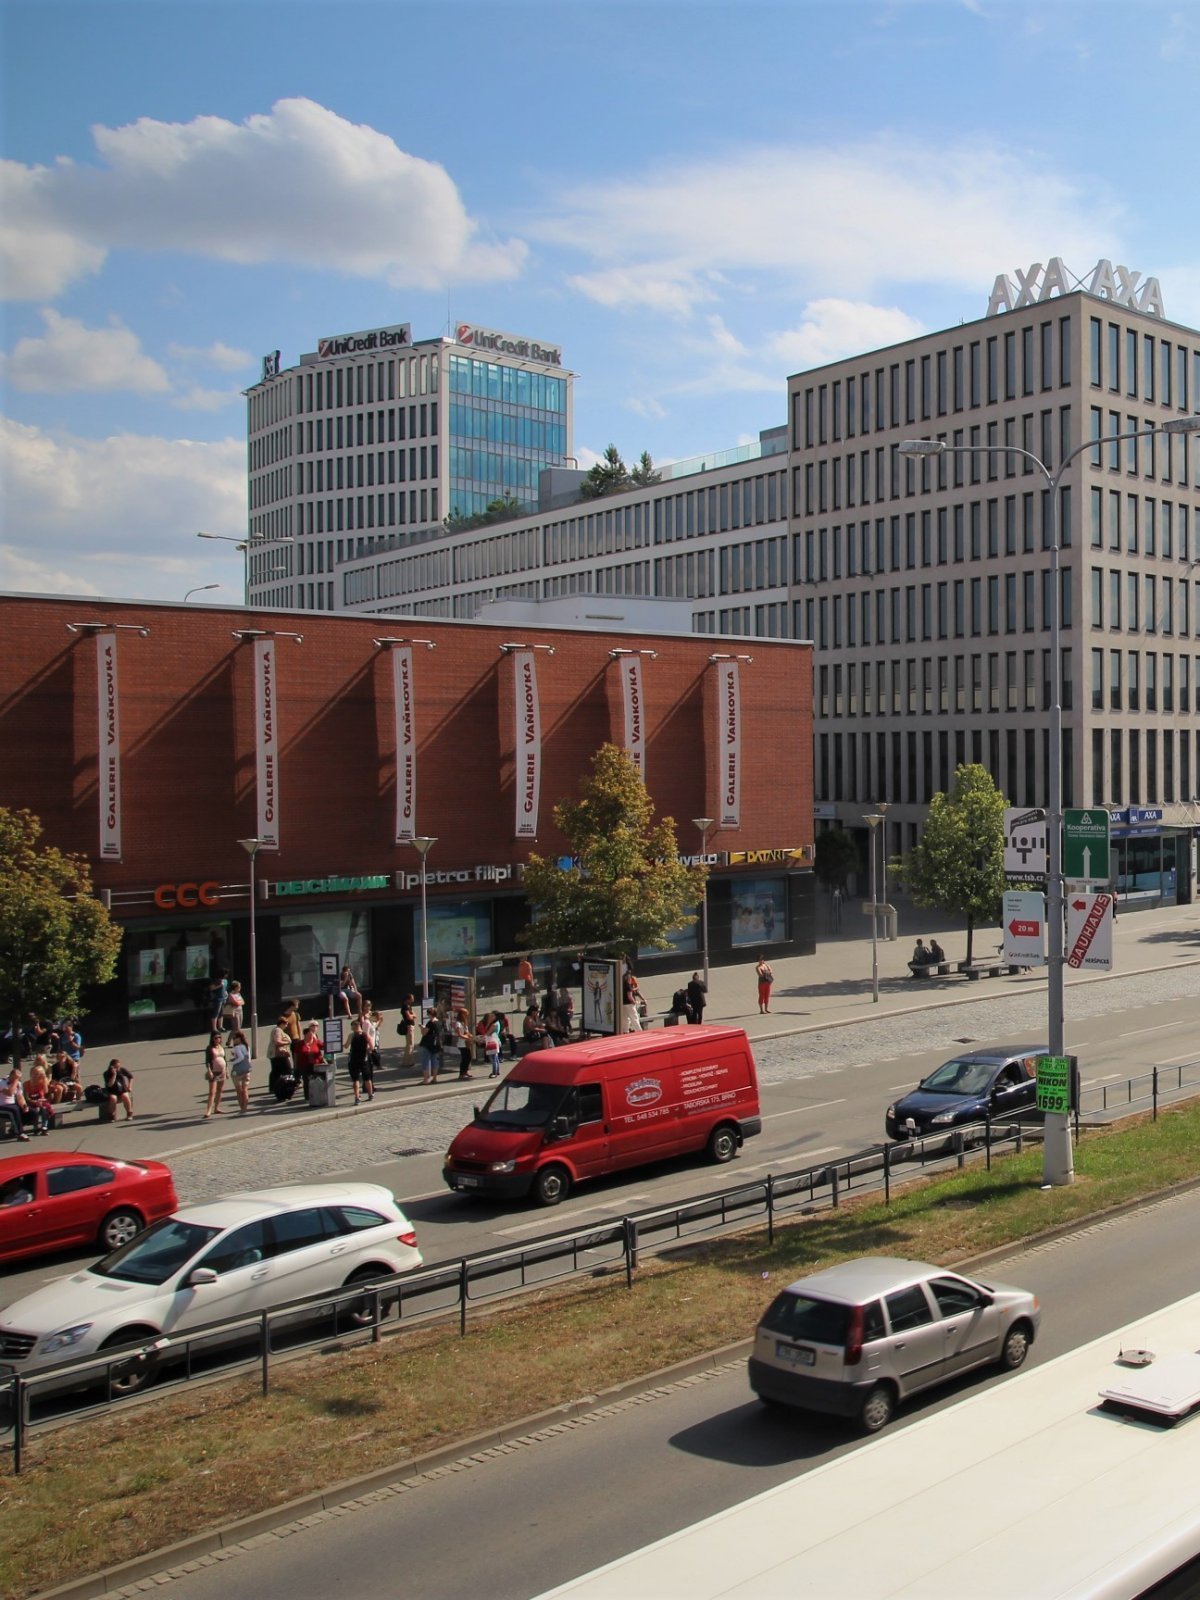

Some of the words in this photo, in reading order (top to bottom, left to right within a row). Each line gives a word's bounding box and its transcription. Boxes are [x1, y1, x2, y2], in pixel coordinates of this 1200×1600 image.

[986, 257, 1071, 317] AXA
[1090, 259, 1166, 319] AXA
[329, 333, 377, 356] UniCredit
[380, 329, 407, 347] Bank
[474, 329, 529, 358] UniCredit
[532, 343, 561, 365] Bank
[105, 646, 115, 746] VAŇKOVKA
[263, 651, 272, 744] VAŇKOVKA
[401, 658, 411, 745] VAŇKOVKA
[523, 662, 535, 744] VAŇKOVKA
[629, 666, 641, 744] VAŇKOVKA
[726, 671, 735, 744] VAŇKOVKA
[107, 756, 116, 829] GALERIE
[265, 754, 273, 823] GALERIE
[403, 754, 412, 818] GALERIE
[524, 753, 535, 813] GALERIE
[727, 752, 735, 806] GALERIE
[1066, 823, 1106, 832] Kooperativa
[1144, 811, 1157, 819] AXA
[154, 881, 219, 908] CCC
[276, 875, 389, 896] DEICHMANN
[1006, 873, 1044, 882] www.tsb.cz
[1069, 895, 1108, 968] BAUHAUS
[722, 1092, 736, 1100] BRNO
[1039, 1077, 1067, 1087] NIKON
[624, 1116, 635, 1124] TEL.
